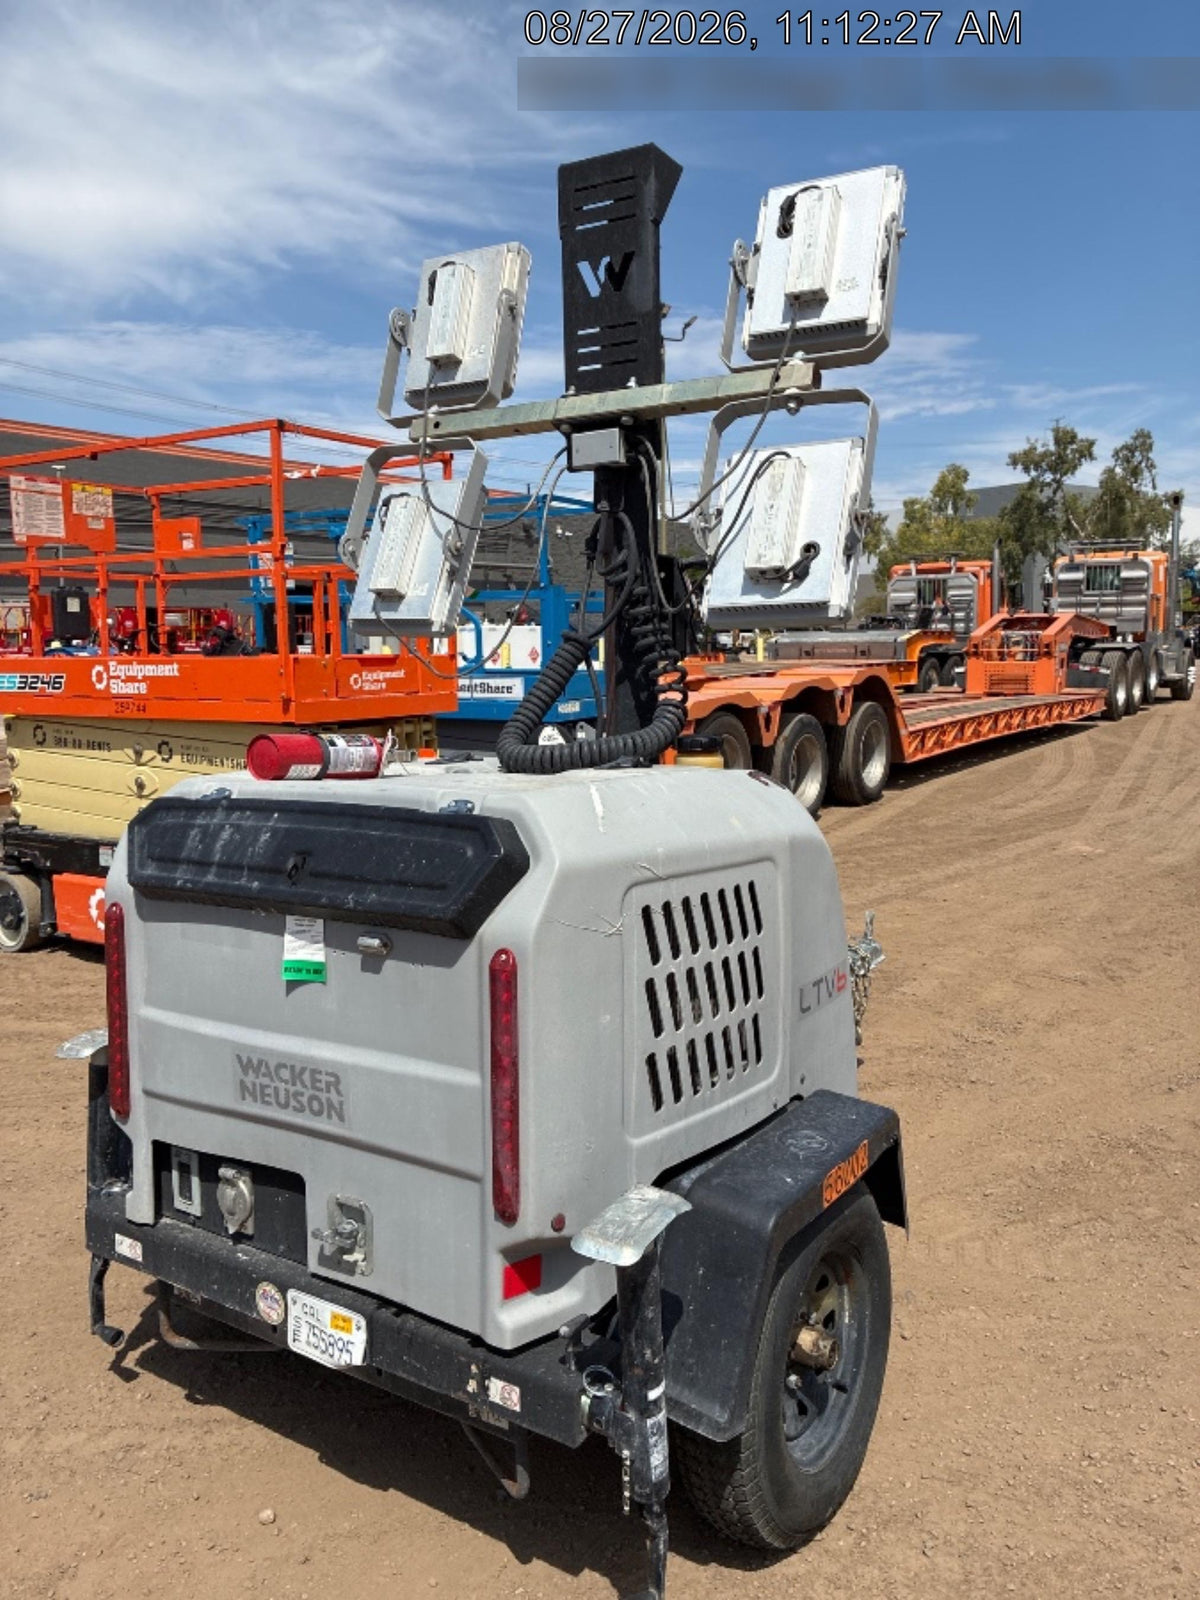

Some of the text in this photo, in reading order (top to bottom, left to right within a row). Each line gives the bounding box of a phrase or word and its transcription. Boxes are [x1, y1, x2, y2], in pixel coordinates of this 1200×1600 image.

[108, 661, 179, 680] Equipment
[110, 679, 148, 694] Share
[799, 966, 848, 1015] LTV6
[235, 1053, 344, 1098] WACKER
[239, 1079, 346, 1123] NEUSON
[301, 1302, 321, 1322] CAL
